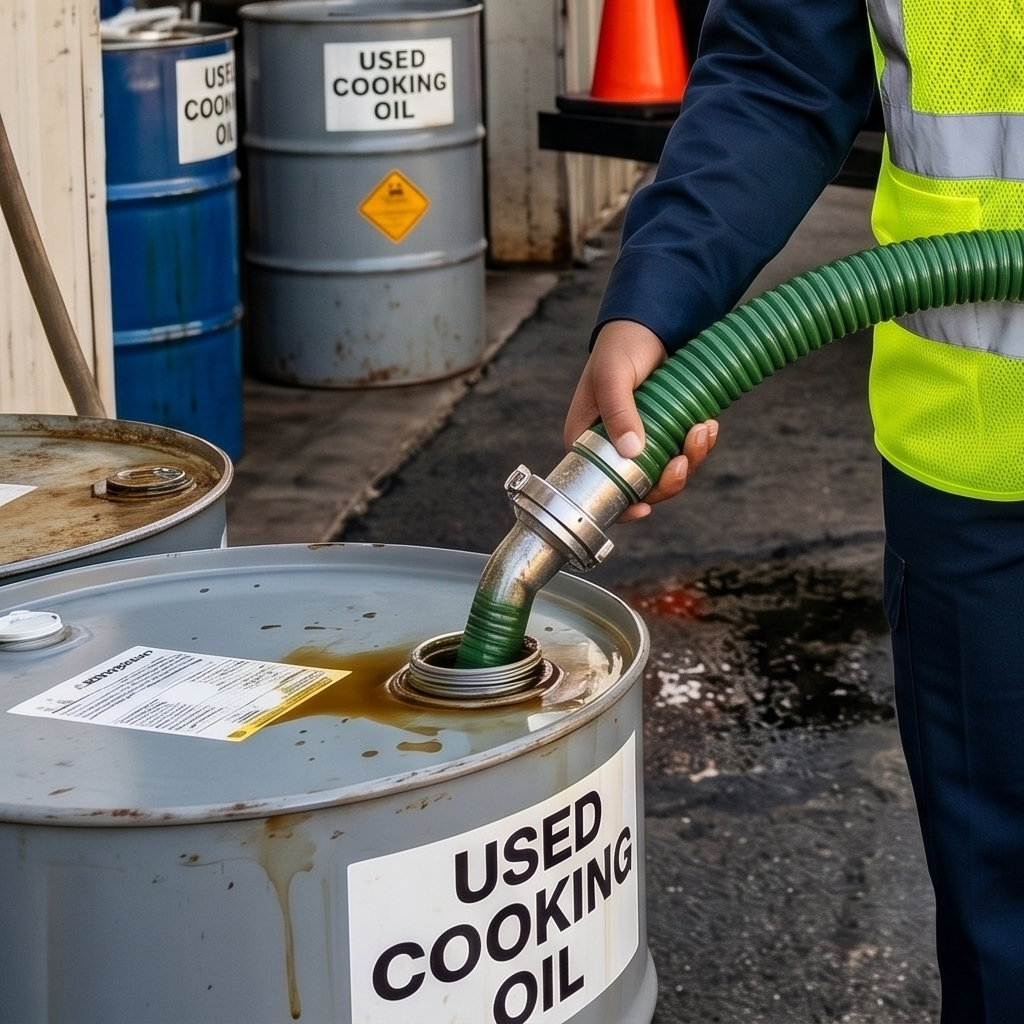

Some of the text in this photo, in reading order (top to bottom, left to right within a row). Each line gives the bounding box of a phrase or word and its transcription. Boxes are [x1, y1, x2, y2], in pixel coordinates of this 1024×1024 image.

[332, 72, 447, 97] COOKING
[359, 49, 426, 71] USED
[374, 100, 415, 121] OIL
[454, 790, 602, 904] USED
[372, 826, 632, 1001] COOKING
[493, 945, 585, 1024] OIL
